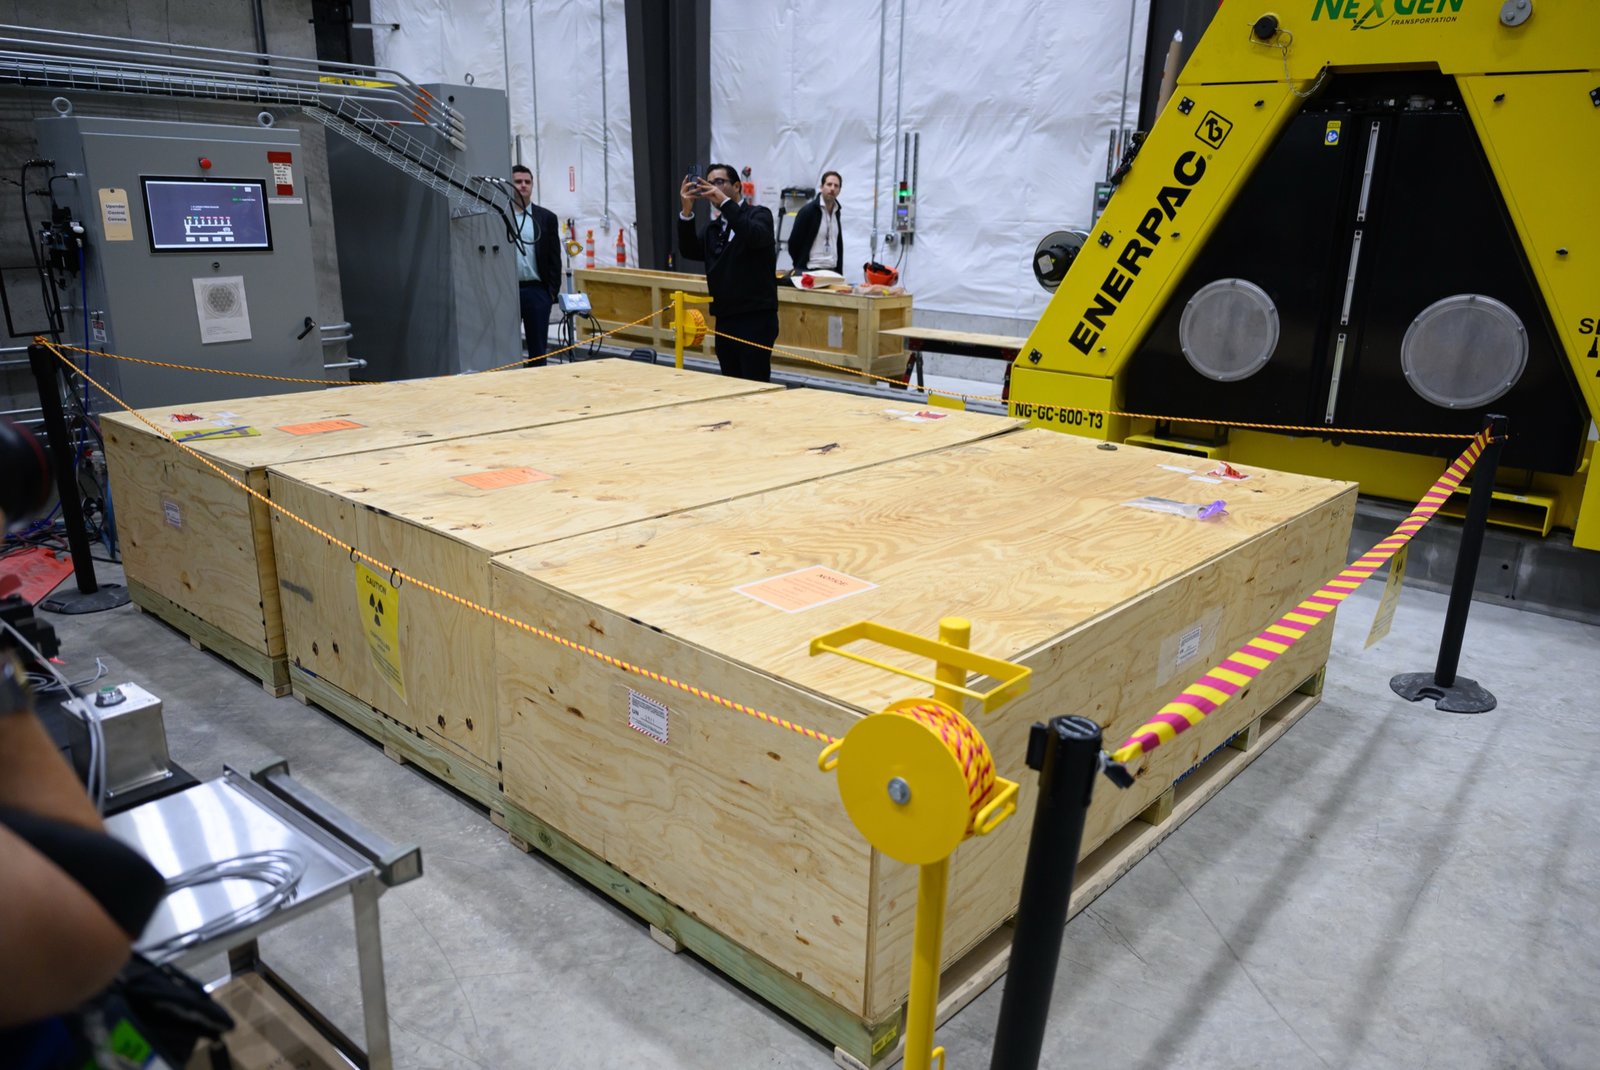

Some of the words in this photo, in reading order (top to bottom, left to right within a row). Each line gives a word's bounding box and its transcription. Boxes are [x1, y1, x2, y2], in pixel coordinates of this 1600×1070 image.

[1390, 16, 1457, 26] TRANSPORTATION
[1068, 150, 1206, 356] ENERPAC
[1015, 403, 1103, 429] NG-GC-600-T3
[365, 575, 387, 596] CAUTION
